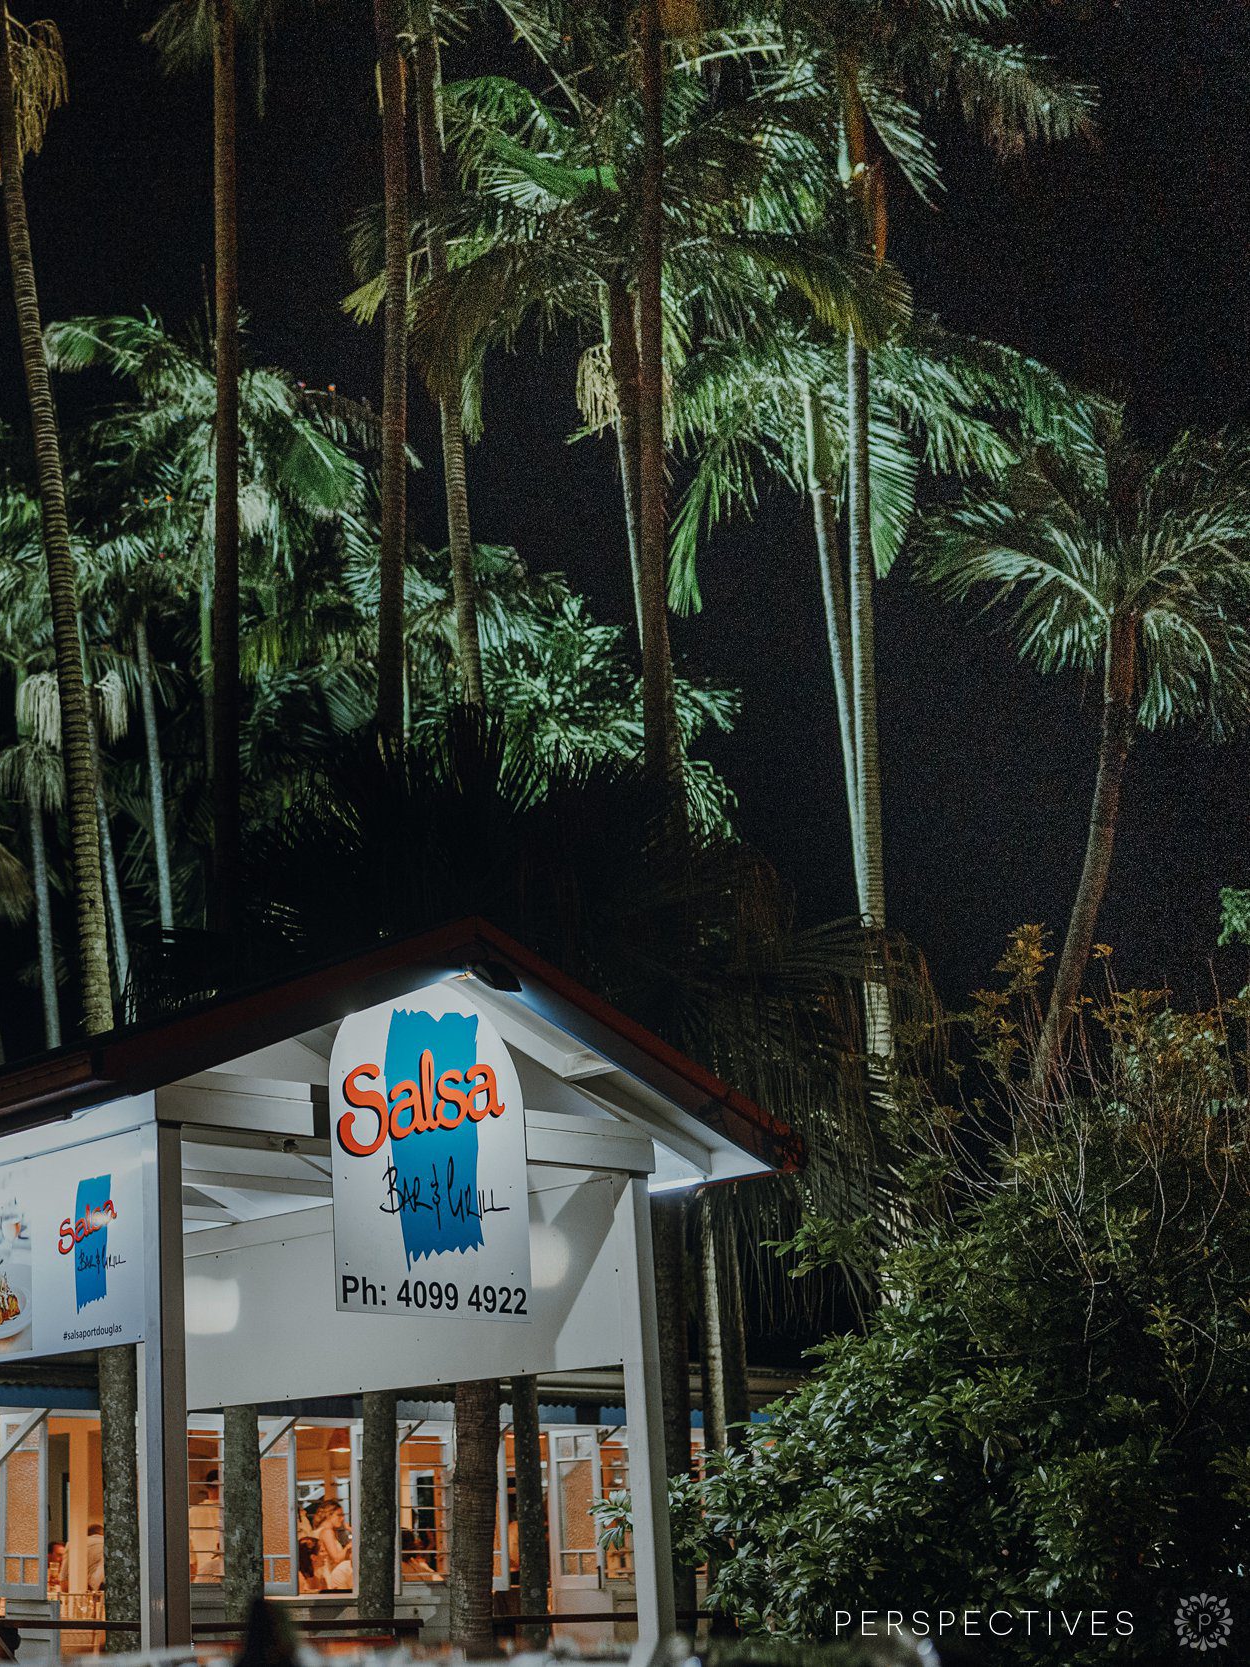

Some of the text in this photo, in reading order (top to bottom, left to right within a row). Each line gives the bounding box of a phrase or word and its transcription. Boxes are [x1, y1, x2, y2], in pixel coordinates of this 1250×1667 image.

[337, 1049, 505, 1157] Salsa
[431, 1163, 442, 1230] &
[342, 1275, 528, 1315] Ph: 4099 4922
[63, 1323, 122, 1341] #salsaportdouglas
